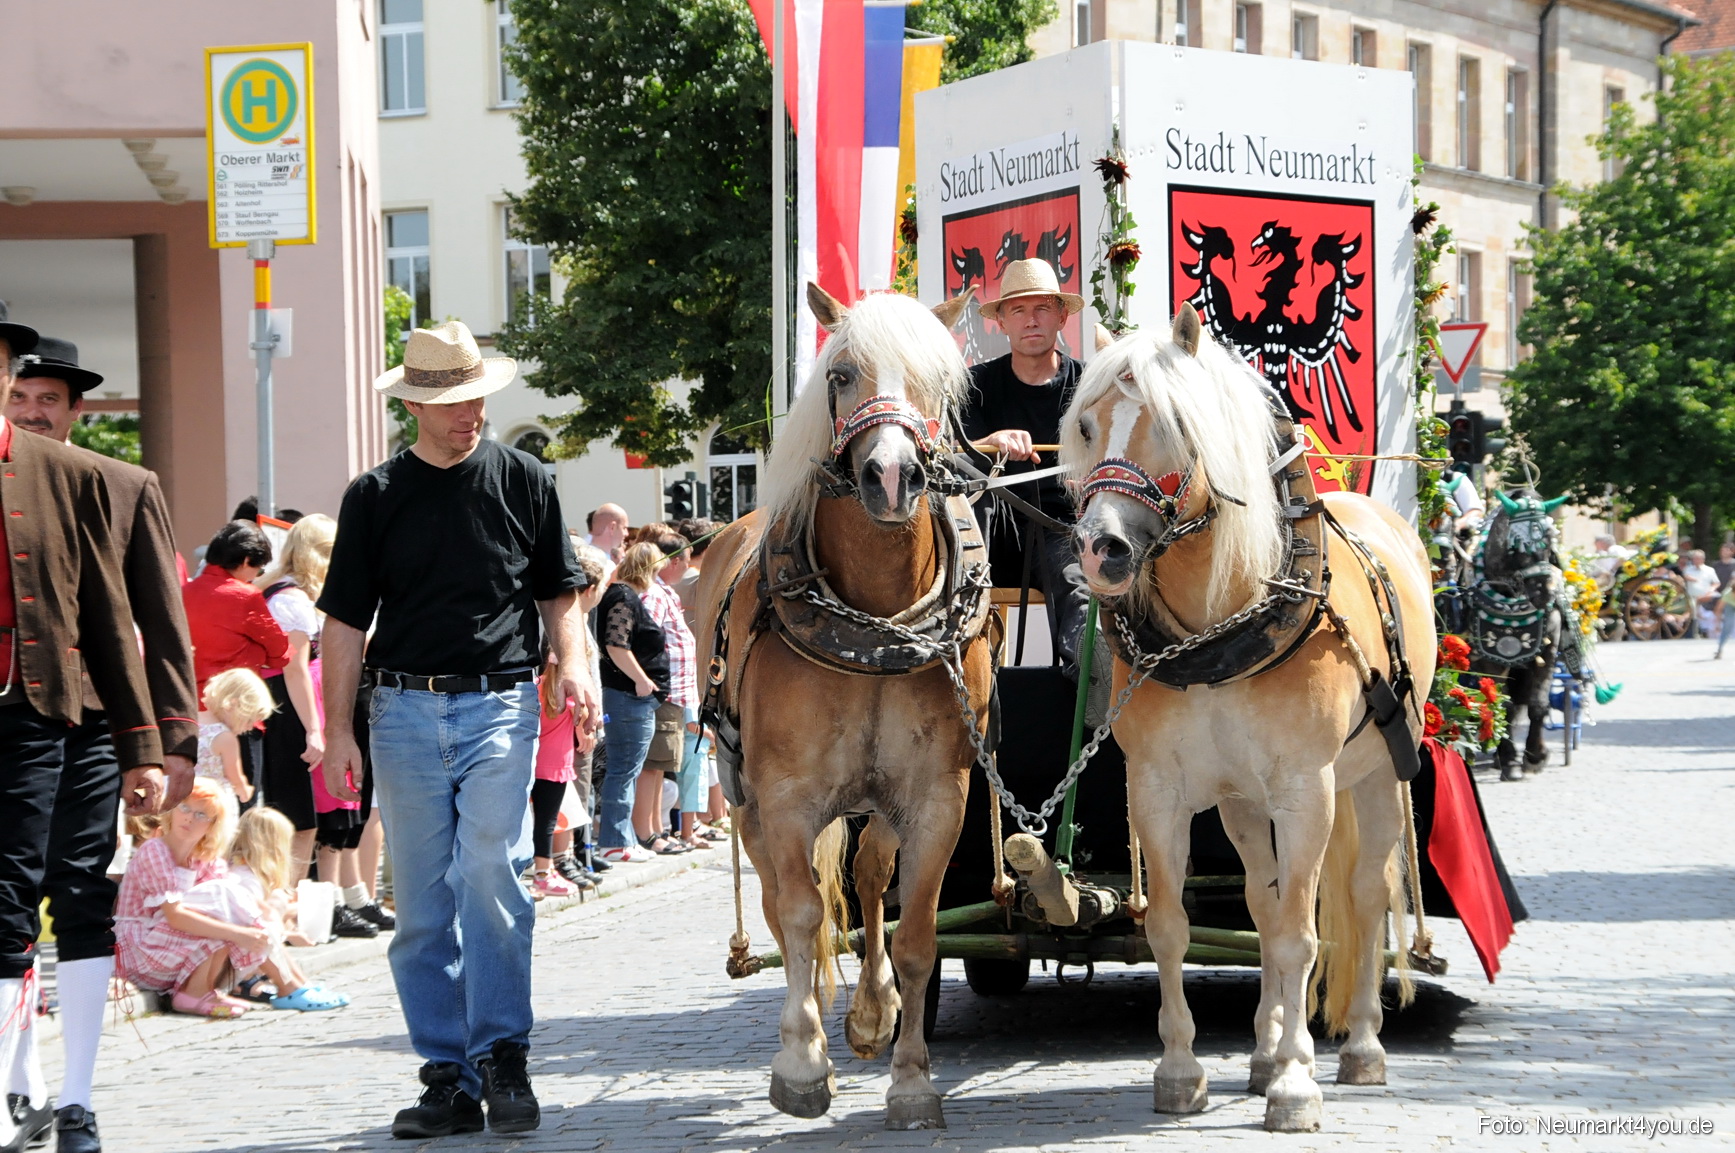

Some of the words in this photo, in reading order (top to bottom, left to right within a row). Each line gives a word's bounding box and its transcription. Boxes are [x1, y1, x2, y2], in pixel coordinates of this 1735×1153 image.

[241, 79, 278, 124] H
[220, 154, 262, 166] Oberer
[266, 152, 300, 164] Markt
[940, 153, 985, 203] Stadt
[990, 130, 1081, 191] Neumarkt
[1165, 127, 1236, 174] Stadt
[1244, 134, 1377, 185] Neumarkt
